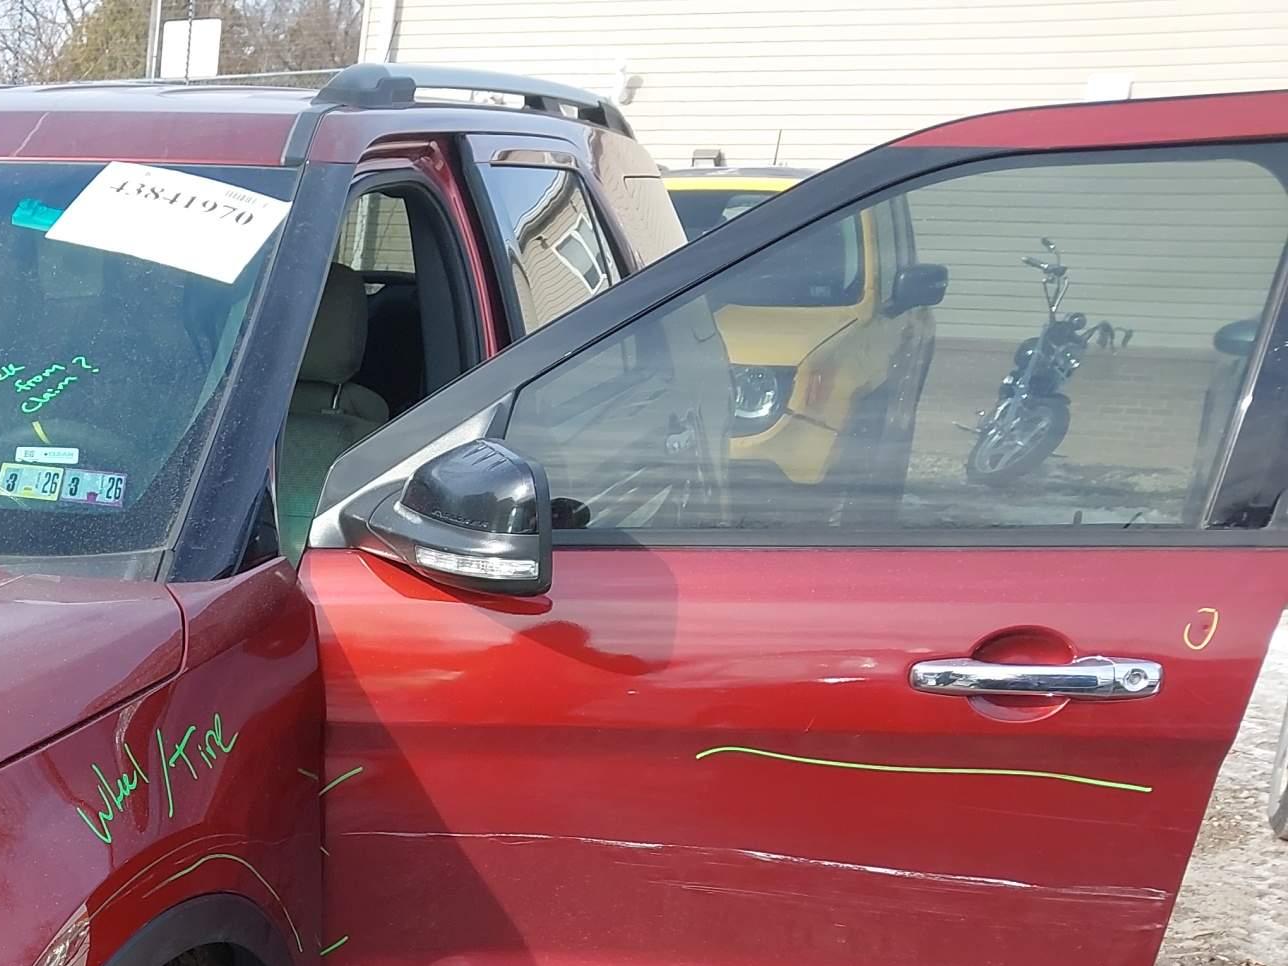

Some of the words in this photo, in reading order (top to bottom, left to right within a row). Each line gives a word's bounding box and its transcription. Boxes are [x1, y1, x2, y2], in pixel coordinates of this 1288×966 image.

[109, 180, 254, 226] 43841970
[41, 471, 60, 495] 26
[105, 476, 123, 500] 26
